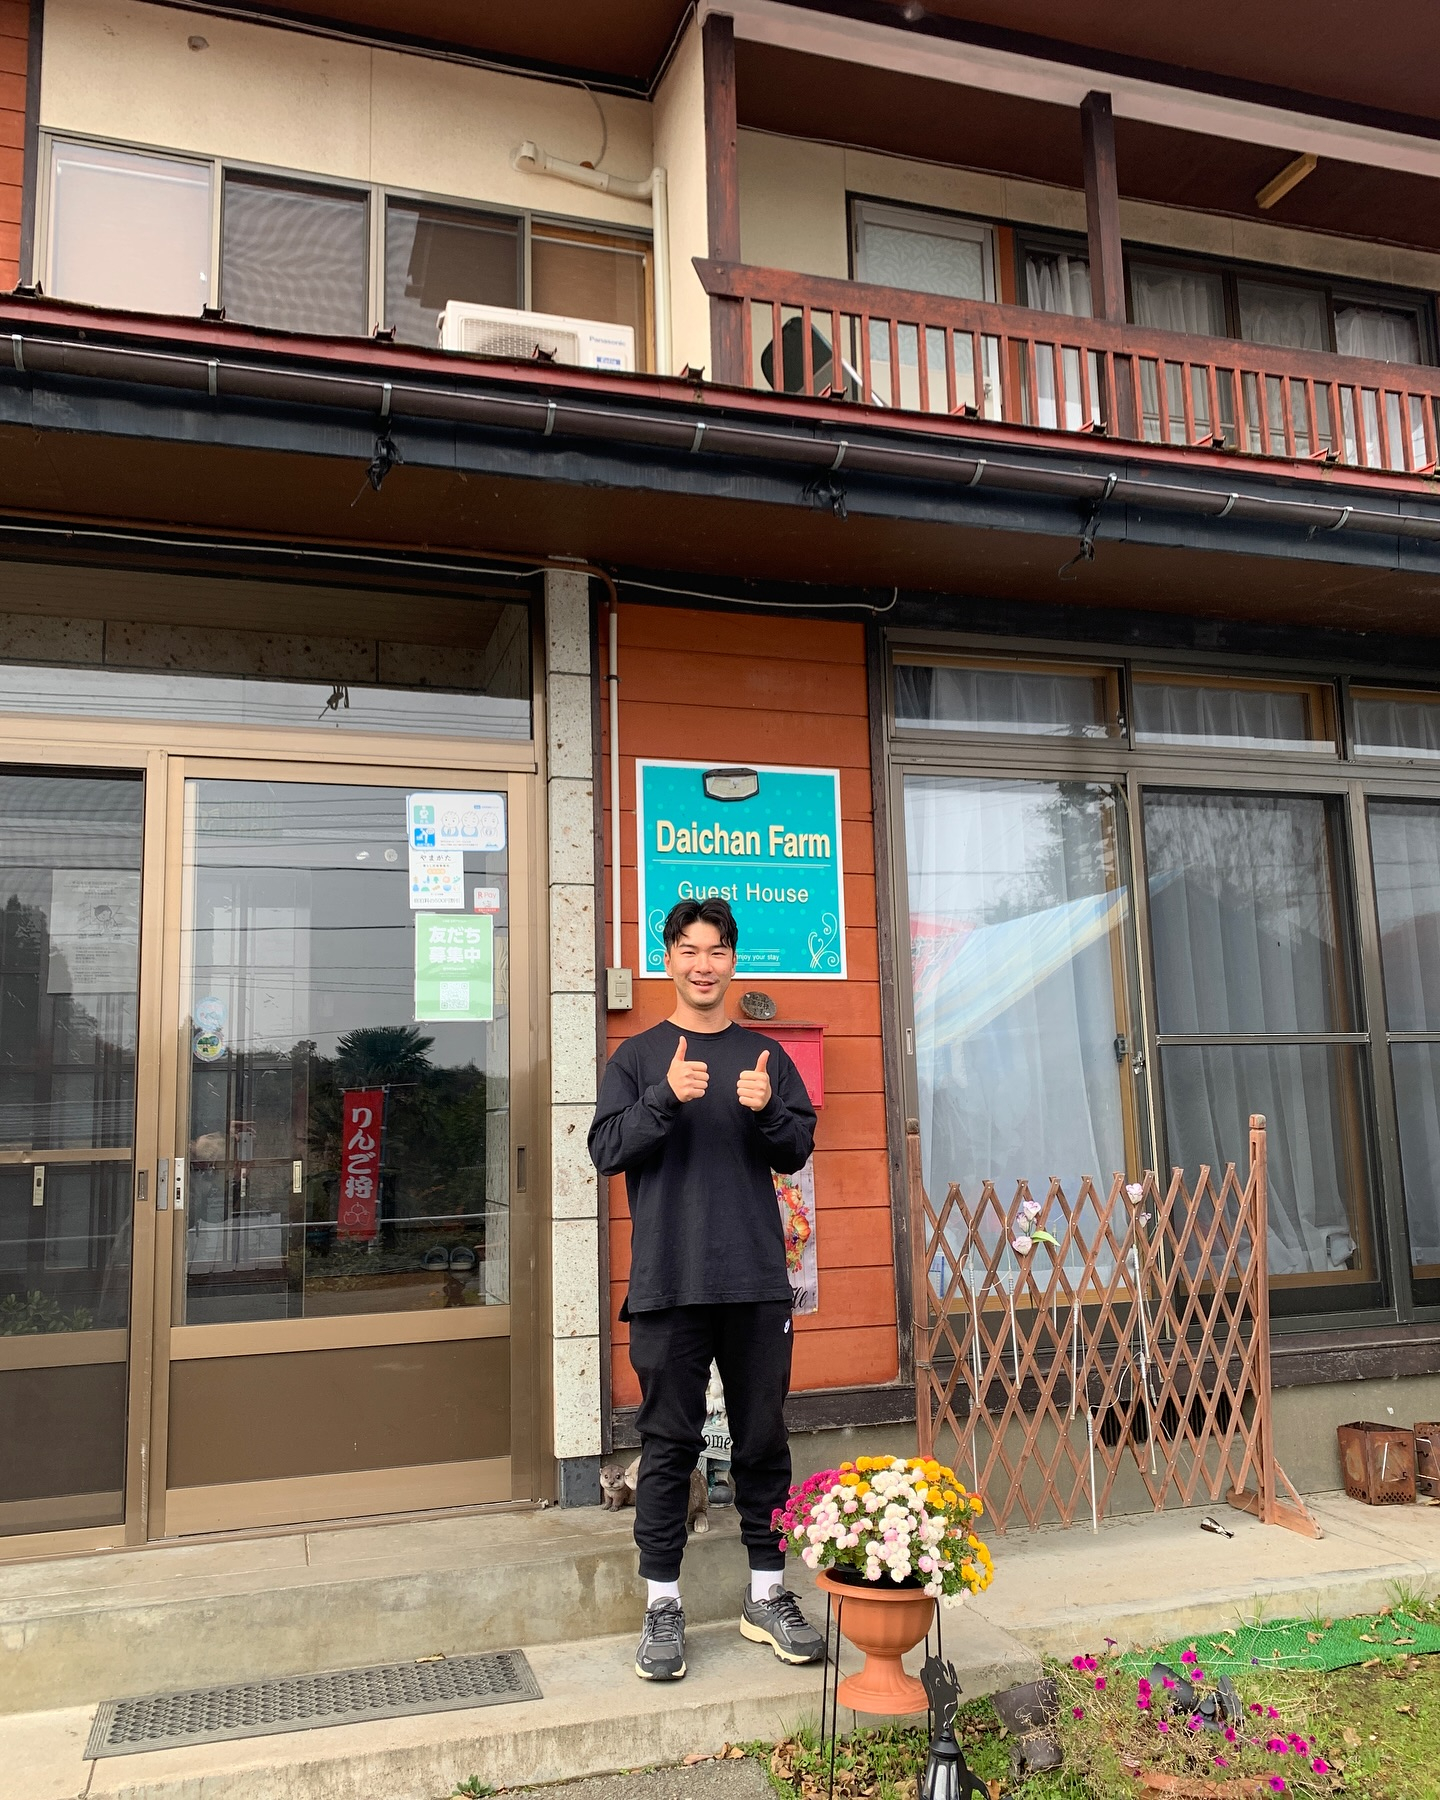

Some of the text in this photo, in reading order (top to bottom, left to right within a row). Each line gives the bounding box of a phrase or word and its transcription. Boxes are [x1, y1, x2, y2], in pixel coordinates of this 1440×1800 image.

[589, 336, 626, 346] Panasonic
[657, 819, 831, 858] Daichan Farm
[678, 880, 809, 903] Guest House
[429, 926, 480, 944] 友だち
[429, 947, 480, 963] 募集中
